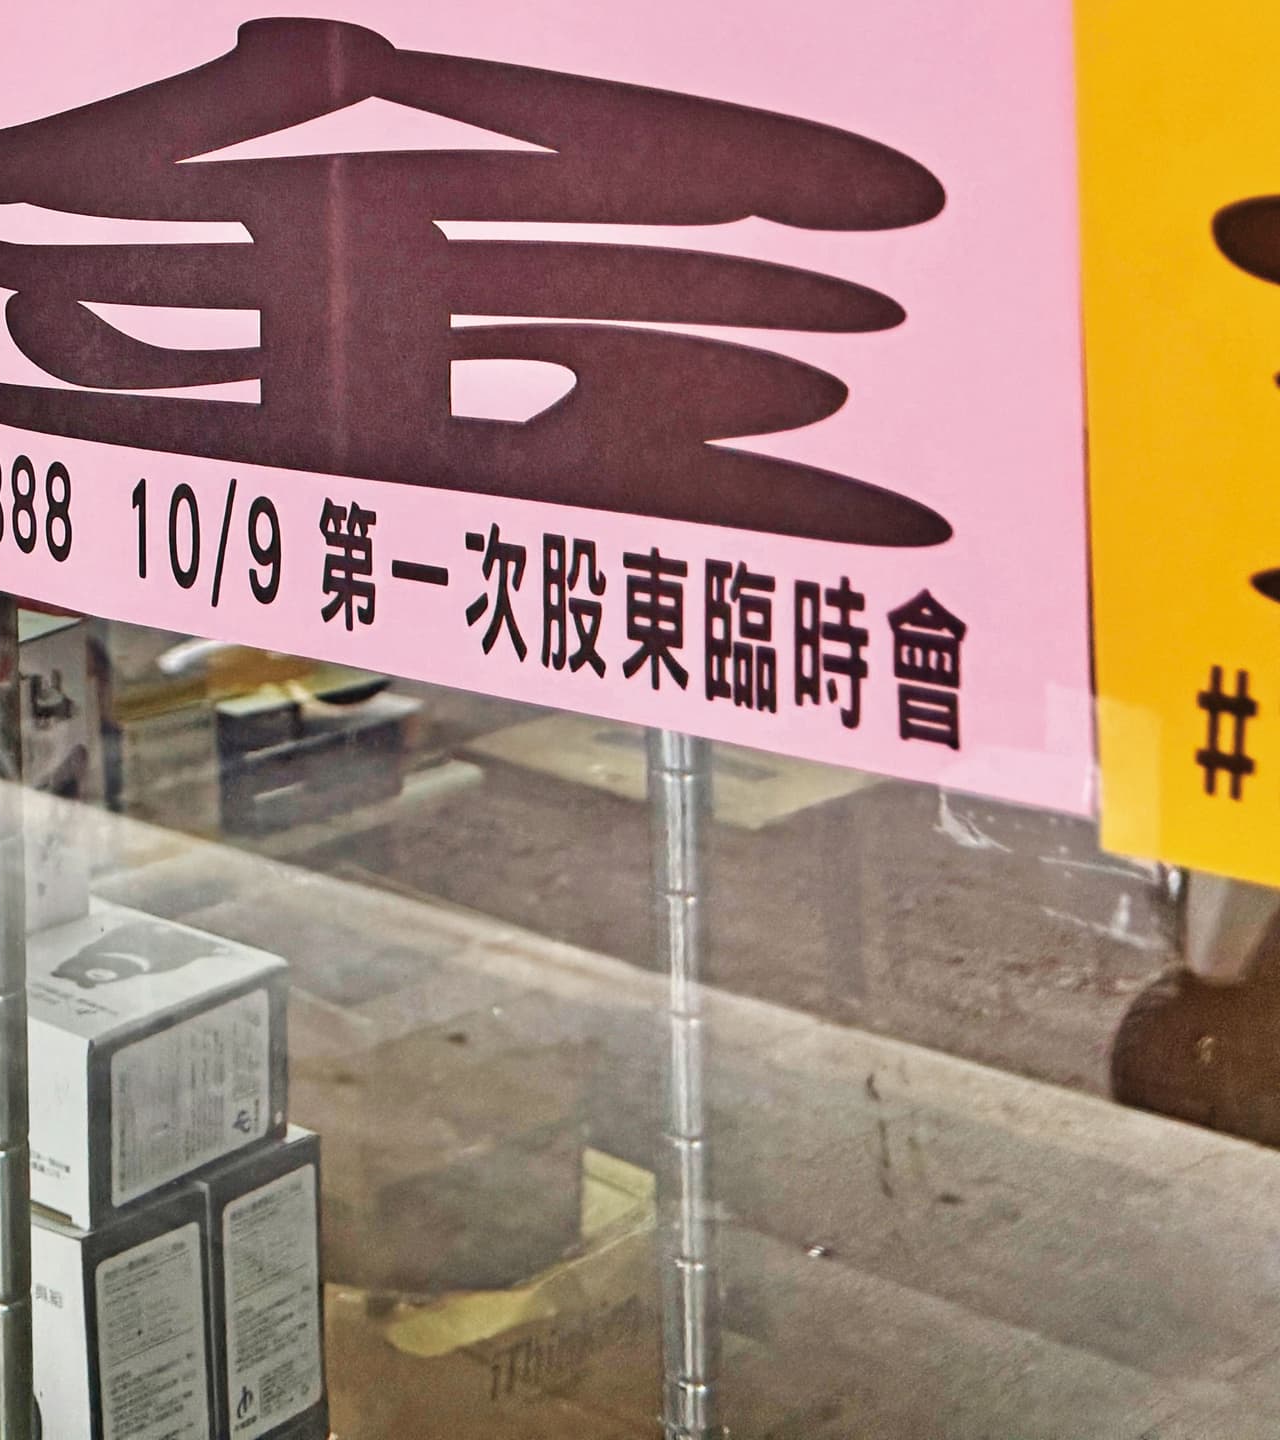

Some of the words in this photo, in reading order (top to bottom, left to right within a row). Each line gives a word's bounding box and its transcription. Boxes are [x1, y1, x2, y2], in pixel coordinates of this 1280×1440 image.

[132, 478, 282, 607] 10/9
[319, 497, 968, 751] 第一次股東臨時會
